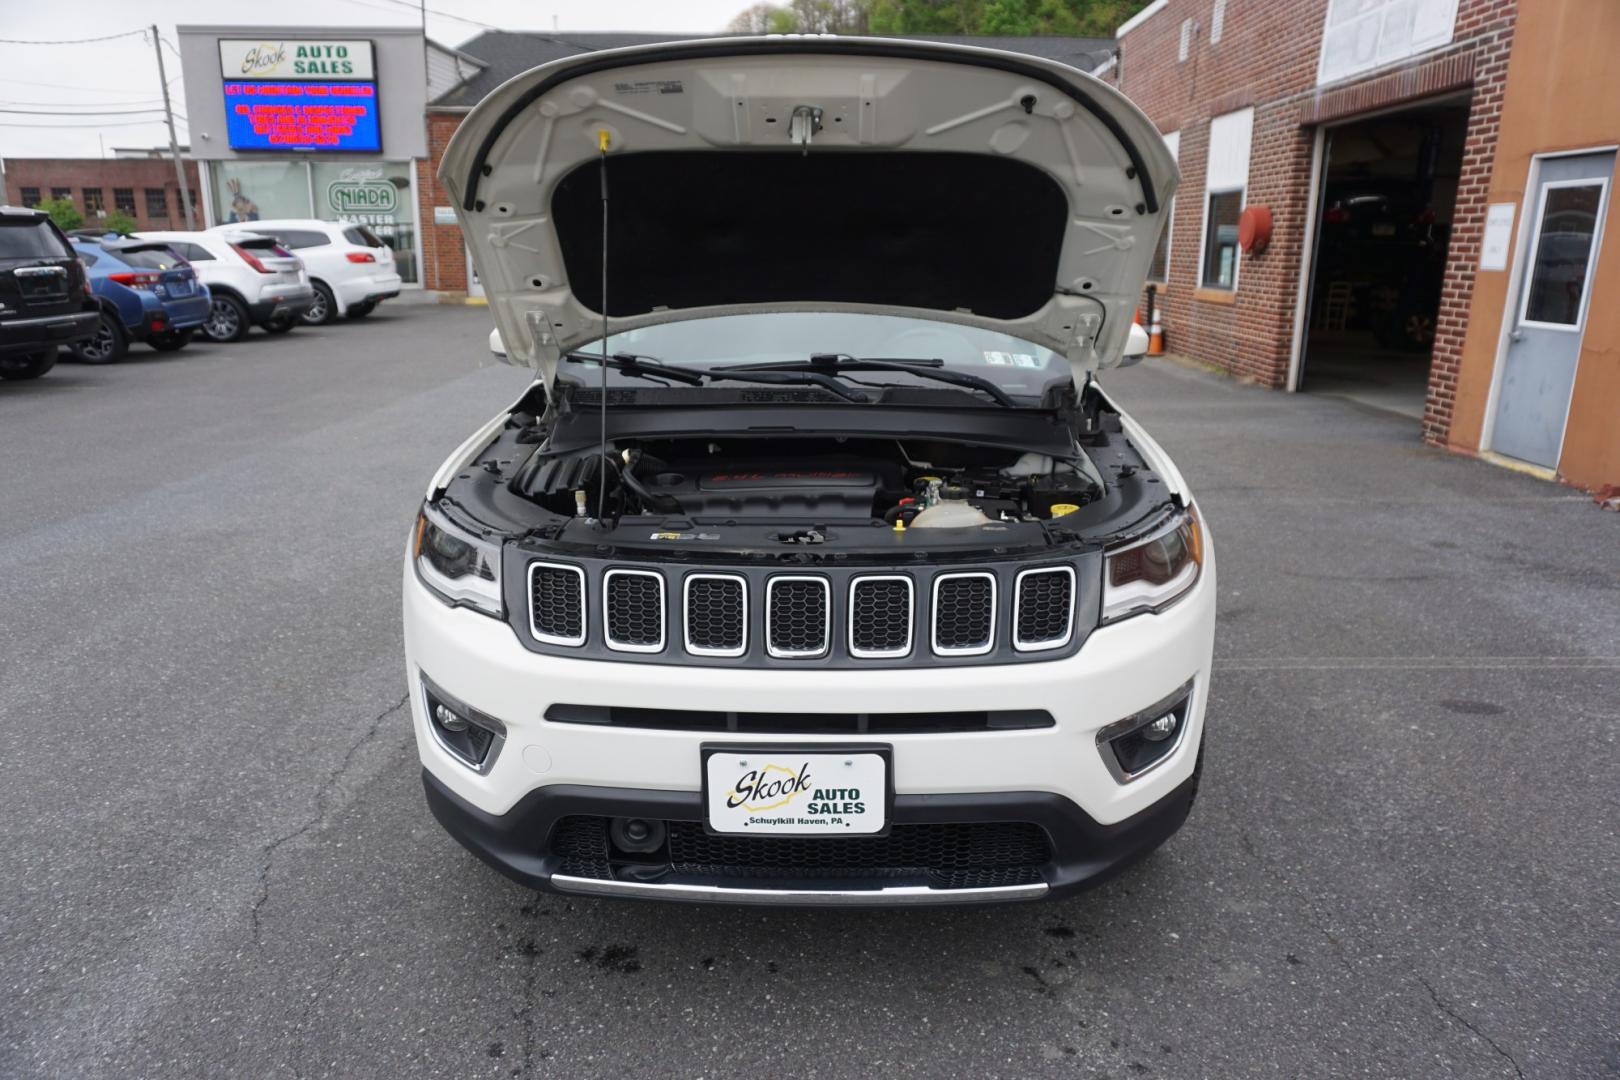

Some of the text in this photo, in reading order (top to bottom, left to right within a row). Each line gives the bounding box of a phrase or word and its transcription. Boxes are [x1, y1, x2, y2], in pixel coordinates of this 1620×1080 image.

[241, 41, 286, 74] Skook
[296, 45, 348, 58] AUTO
[293, 60, 353, 74] SALES
[334, 188, 390, 205] NIADA
[726, 762, 811, 809] Skook
[812, 788, 860, 801] AUTO
[807, 802, 866, 815] SALES
[749, 816, 843, 826] Schuylkill Haven, PA
